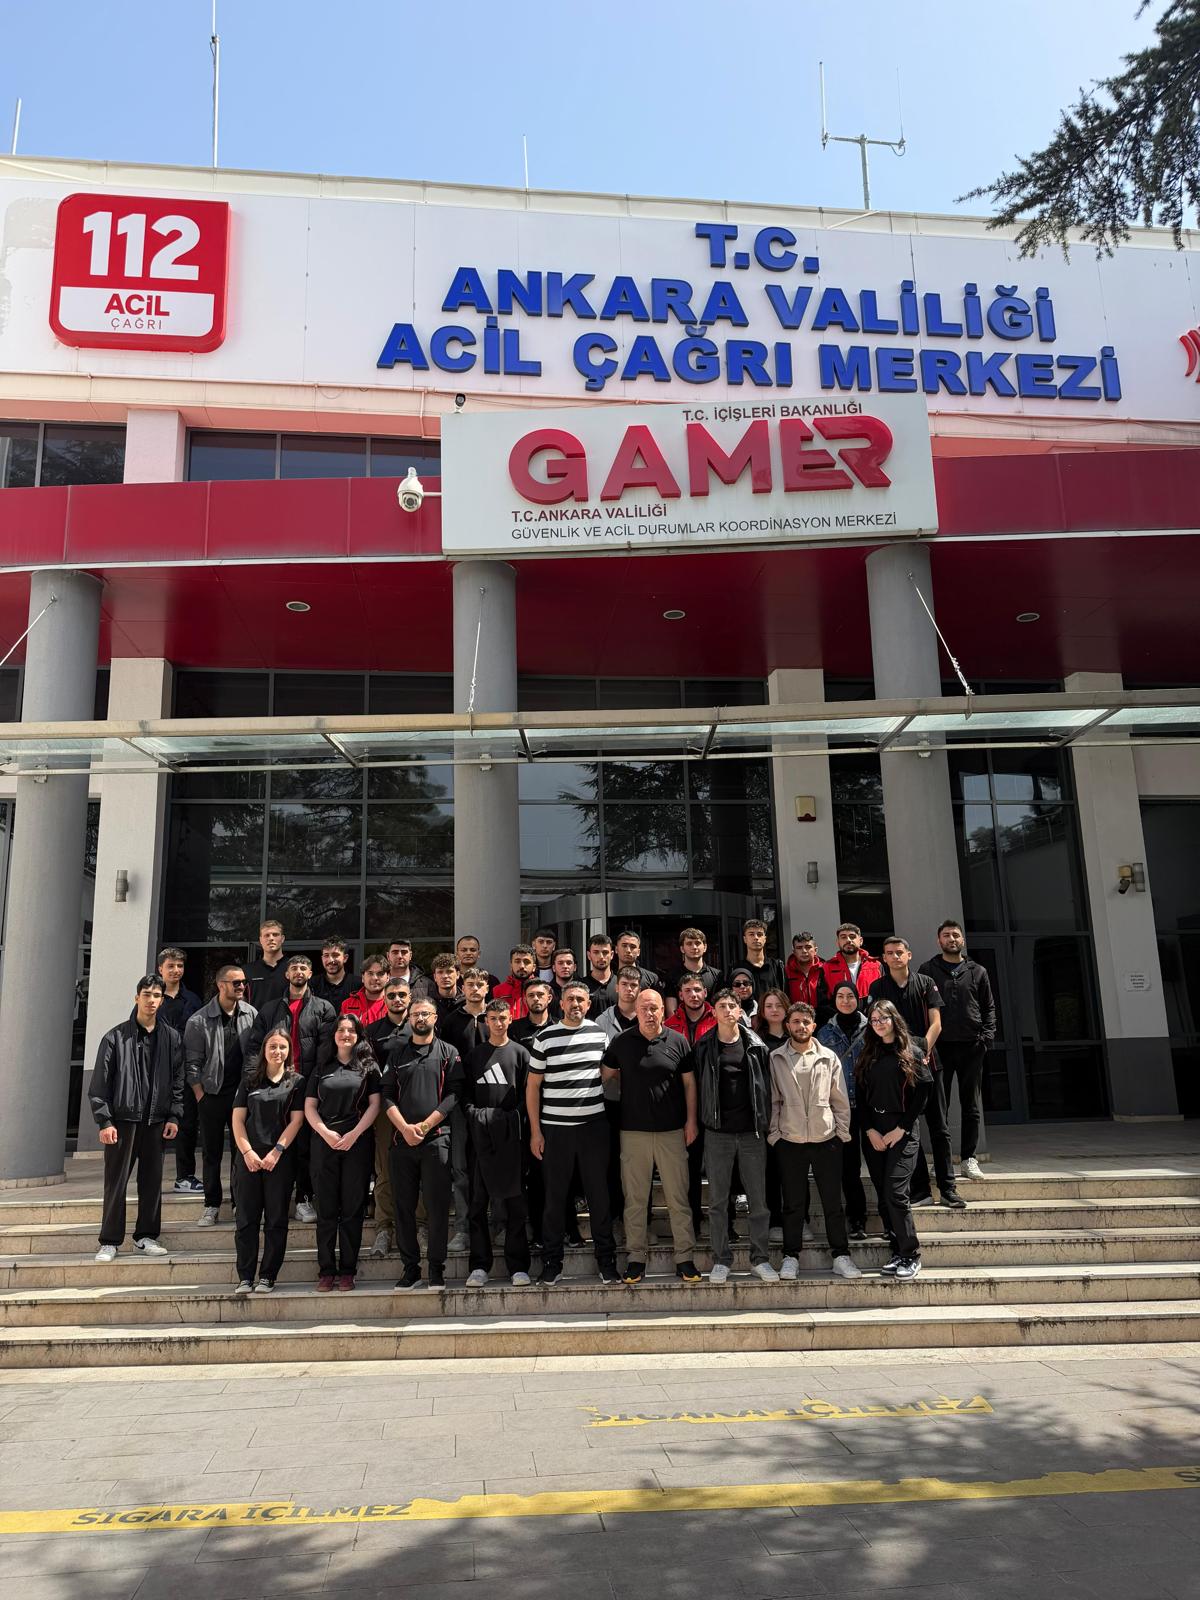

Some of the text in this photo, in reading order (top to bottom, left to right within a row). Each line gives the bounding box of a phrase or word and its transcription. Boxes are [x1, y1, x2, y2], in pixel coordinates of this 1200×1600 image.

[83, 211, 200, 281] 112
[695, 222, 820, 273] T.C.
[111, 317, 162, 331] ÇAĞRI
[442, 266, 1057, 342] ANKARA VALİLİĞİ
[377, 315, 1122, 402] ACİL ÇAĞRI MERKEZİ
[683, 401, 862, 423] T.C. İÇİŞLERİ BAKANLIĞI
[509, 415, 893, 505] GAMER
[511, 511, 897, 540] GÜVENLİK VE ACİL DURUMLAR KOORDİNASYON MERKEZİ
[605, 503, 668, 519] VALİLİĞİ
